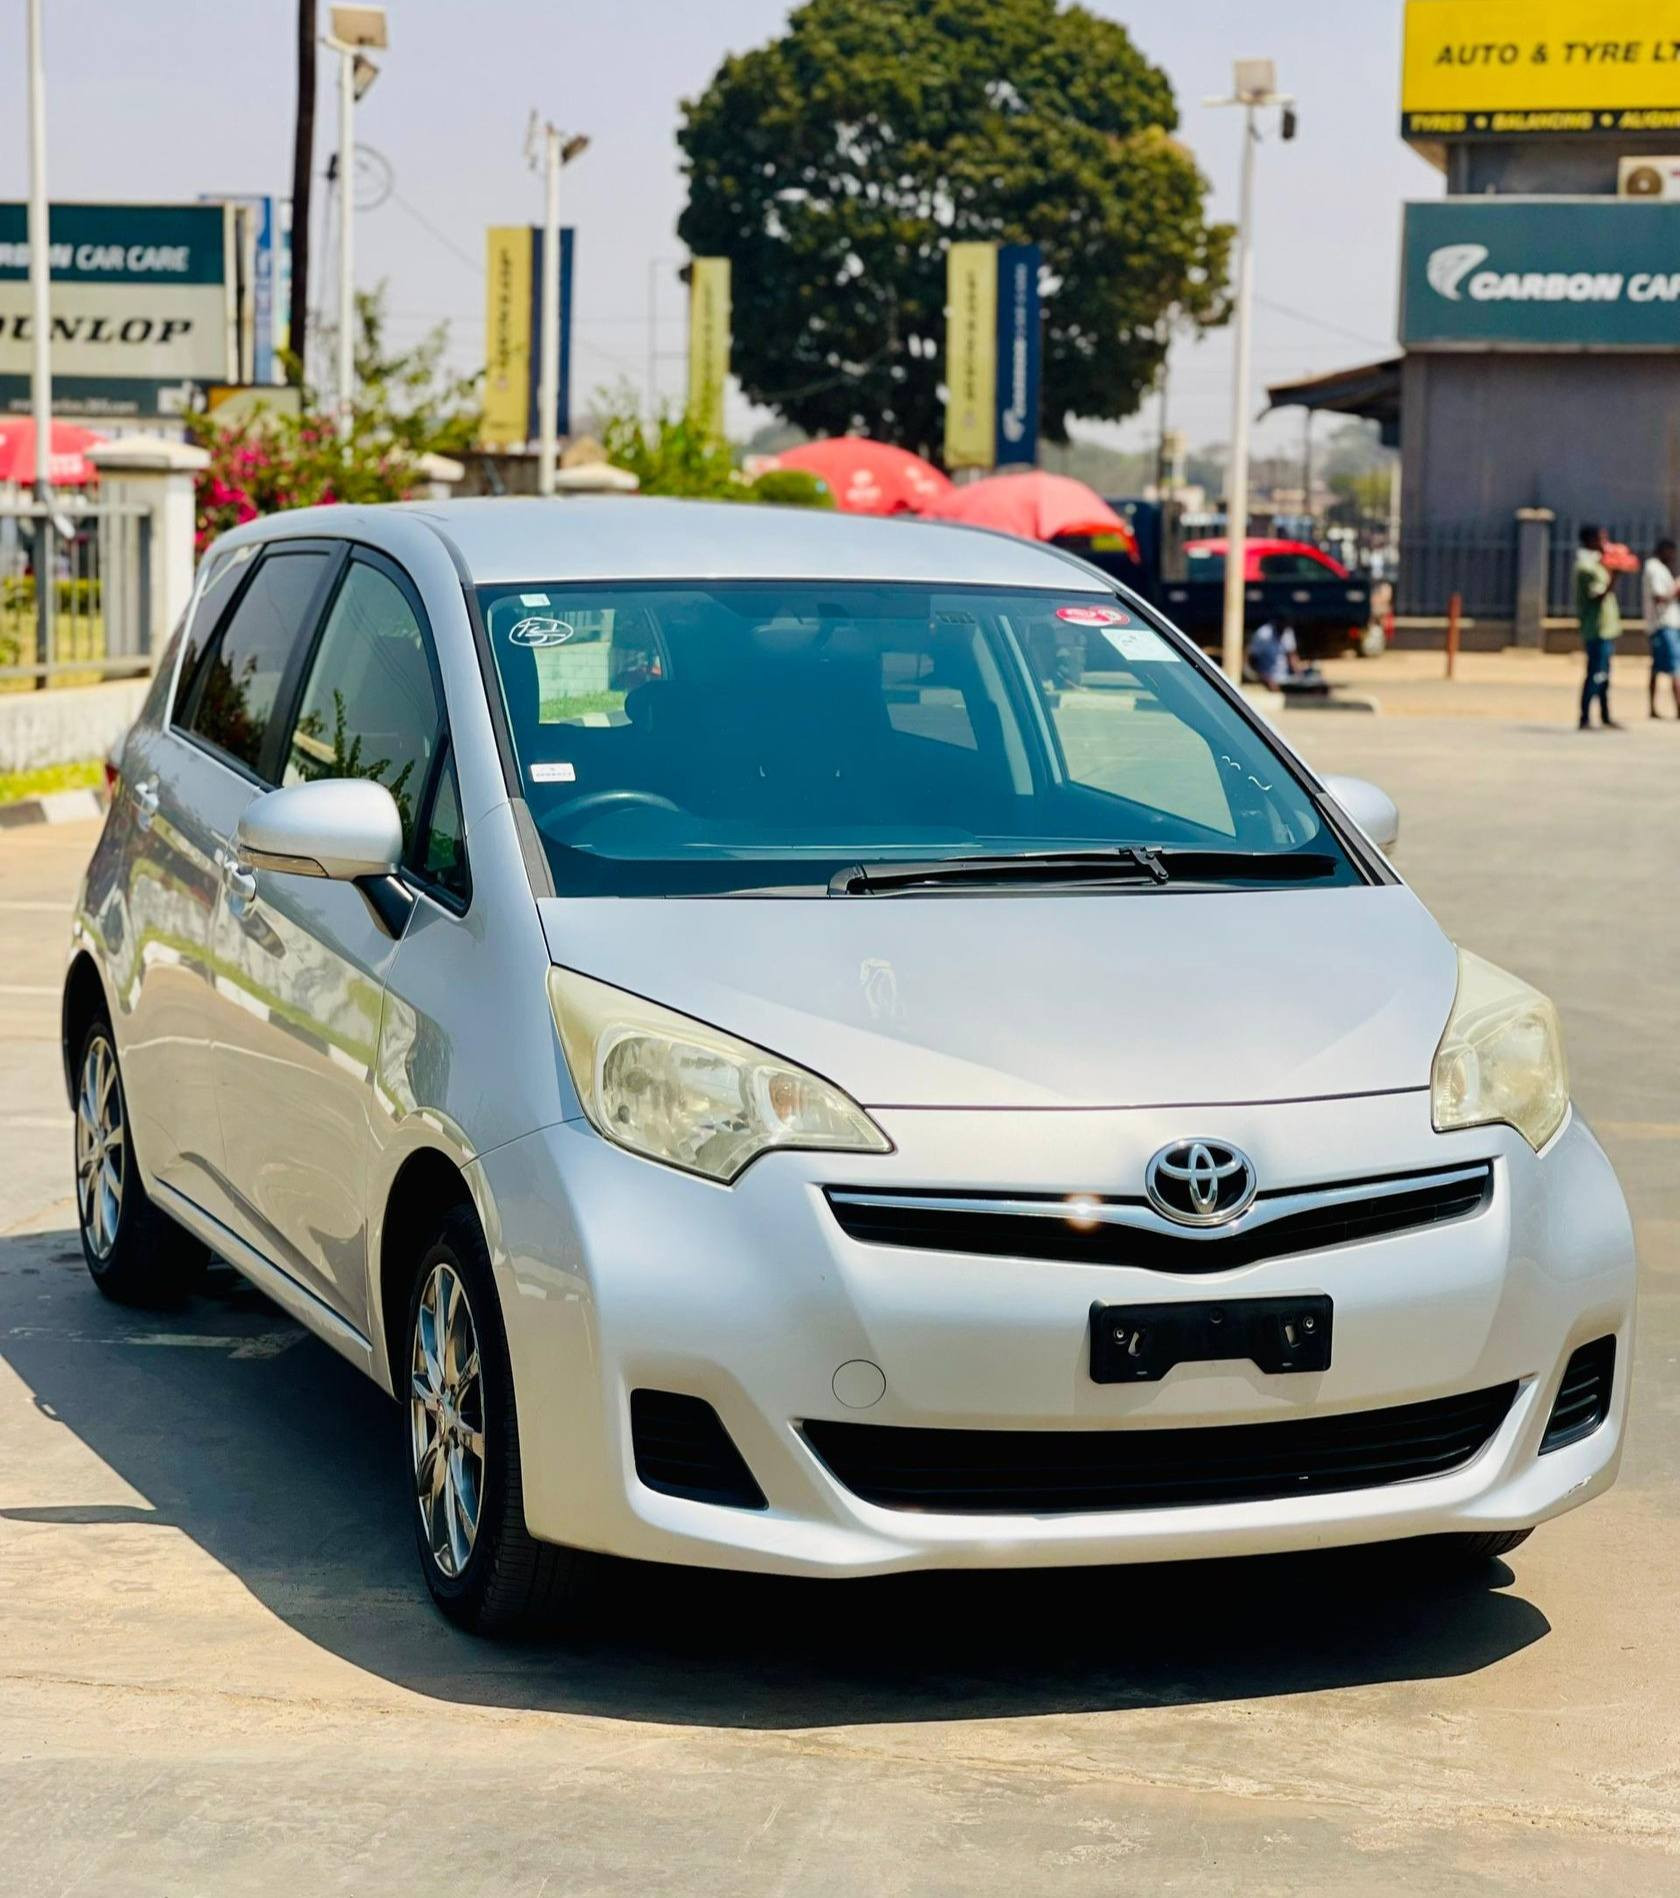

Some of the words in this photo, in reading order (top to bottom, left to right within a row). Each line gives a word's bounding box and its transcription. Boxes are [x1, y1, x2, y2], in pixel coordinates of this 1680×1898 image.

[1436, 43, 1518, 65] AUTO
[1531, 44, 1548, 64] &
[1564, 42, 1641, 63] TYRE
[75, 244, 125, 271] CAR
[126, 246, 190, 272] CARE
[1468, 271, 1623, 301] CARBON
[0, 313, 193, 344] UNLOP
